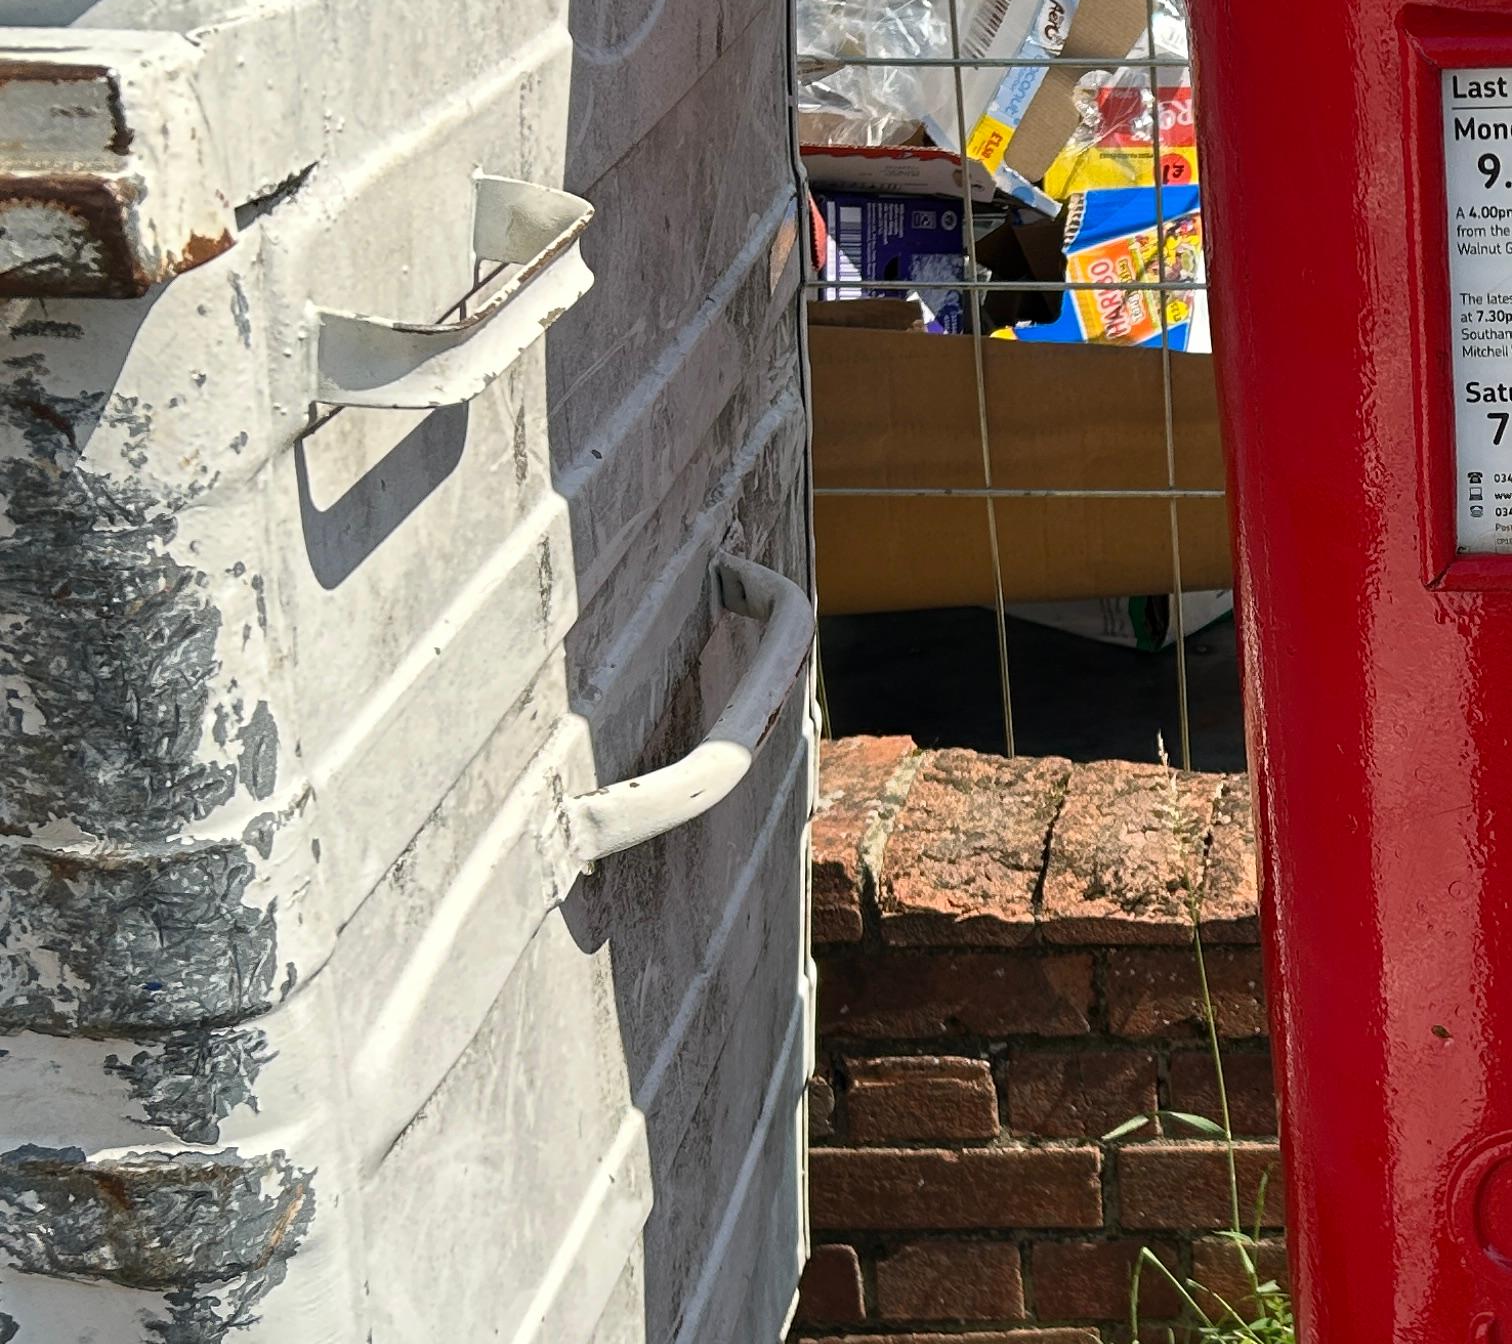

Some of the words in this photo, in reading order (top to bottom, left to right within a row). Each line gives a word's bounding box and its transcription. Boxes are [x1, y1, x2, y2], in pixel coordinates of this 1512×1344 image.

[1450, 73, 1508, 100] Last
[1455, 206, 1466, 220] A
[1456, 224, 1487, 238] from
[1490, 223, 1511, 237] the
[1456, 241, 1502, 256] Walnut
[1458, 292, 1483, 306] The
[1460, 311, 1473, 324] at
[1461, 344, 1509, 359] Mitchell
